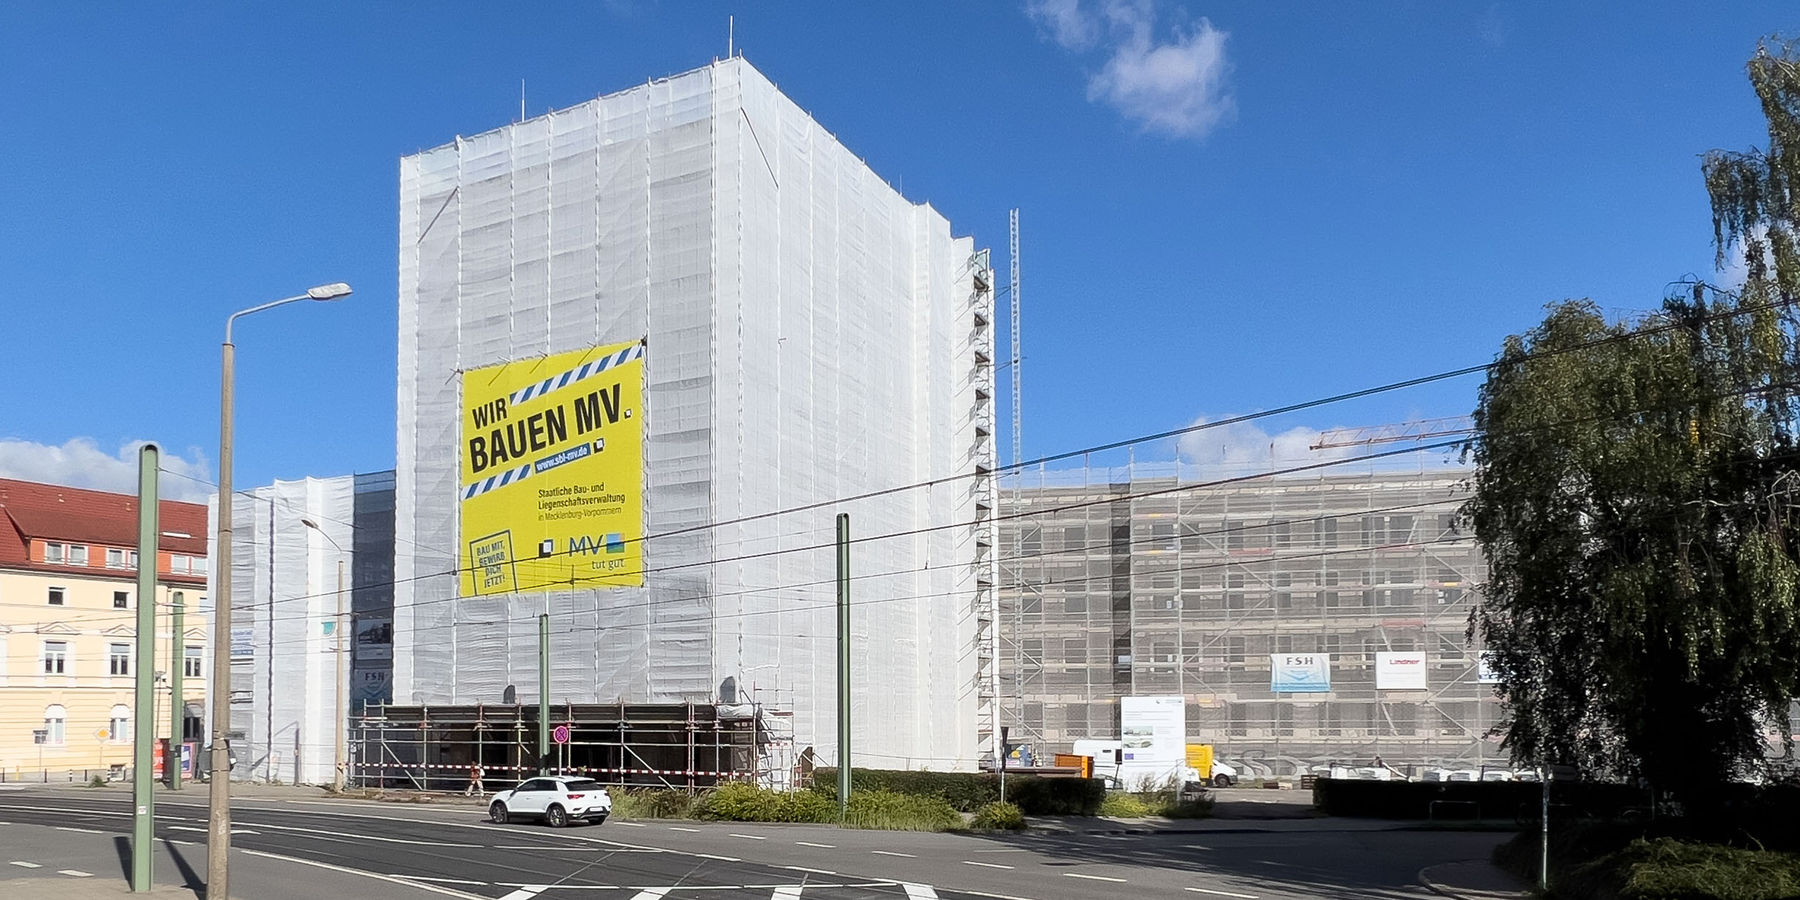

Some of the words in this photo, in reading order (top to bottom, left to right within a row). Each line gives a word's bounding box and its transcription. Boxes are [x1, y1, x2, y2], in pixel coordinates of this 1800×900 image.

[472, 397, 507, 430] WIR
[469, 404, 568, 474] BAUEN
[538, 486, 572, 498] Staatliche
[573, 485, 590, 495] Bau-
[591, 481, 605, 492] und
[538, 493, 626, 511] Liegenschaftsverwaltung
[476, 544, 491, 556] BAU
[569, 534, 603, 557] MV
[592, 560, 605, 570] tut
[608, 559, 625, 571] gut
[1286, 656, 1314, 666] FSH
[365, 672, 384, 681] FSH
